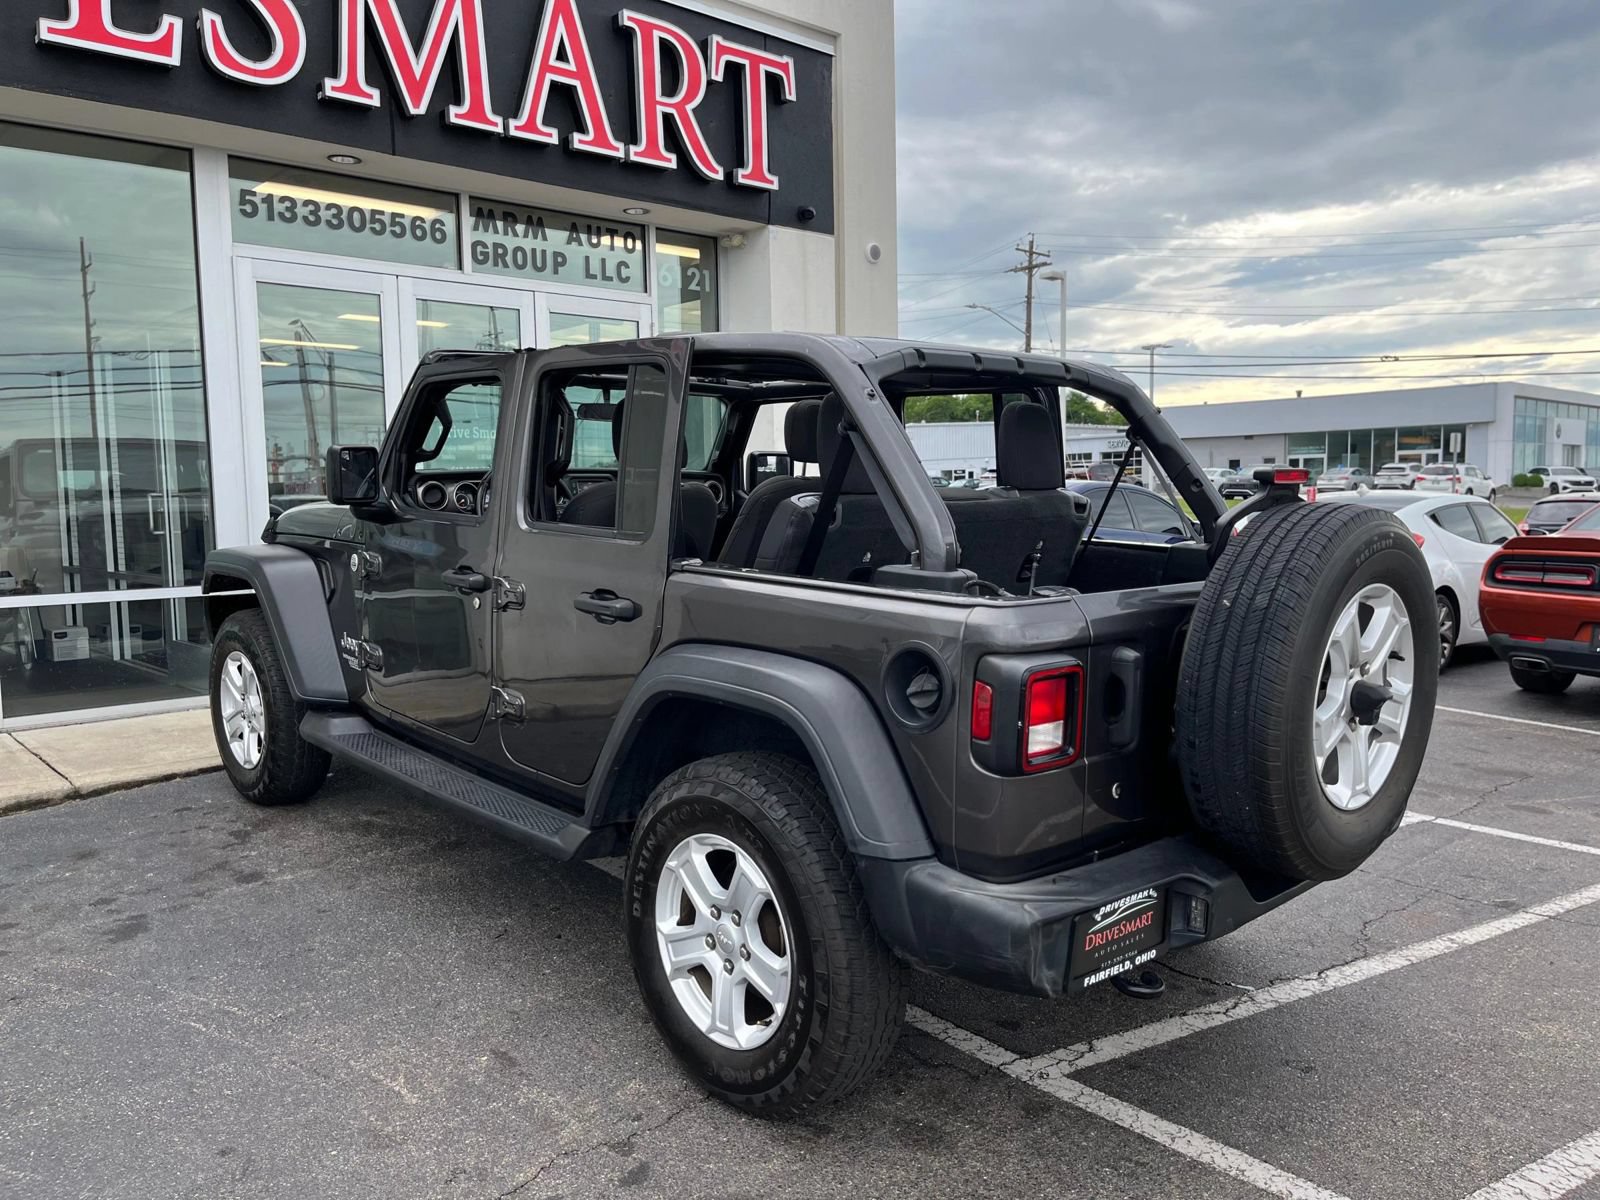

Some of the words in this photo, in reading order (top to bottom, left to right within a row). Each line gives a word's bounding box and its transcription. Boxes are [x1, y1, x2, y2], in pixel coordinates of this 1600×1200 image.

[239, 188, 447, 245] 5133305566
[473, 206, 548, 242] MRM
[566, 221, 636, 255] AUTO
[471, 239, 567, 275] GROUP
[585, 255, 631, 284] LLC
[1083, 960, 1133, 988] FAIRFIELD,
[1135, 949, 1157, 966] OHIO
